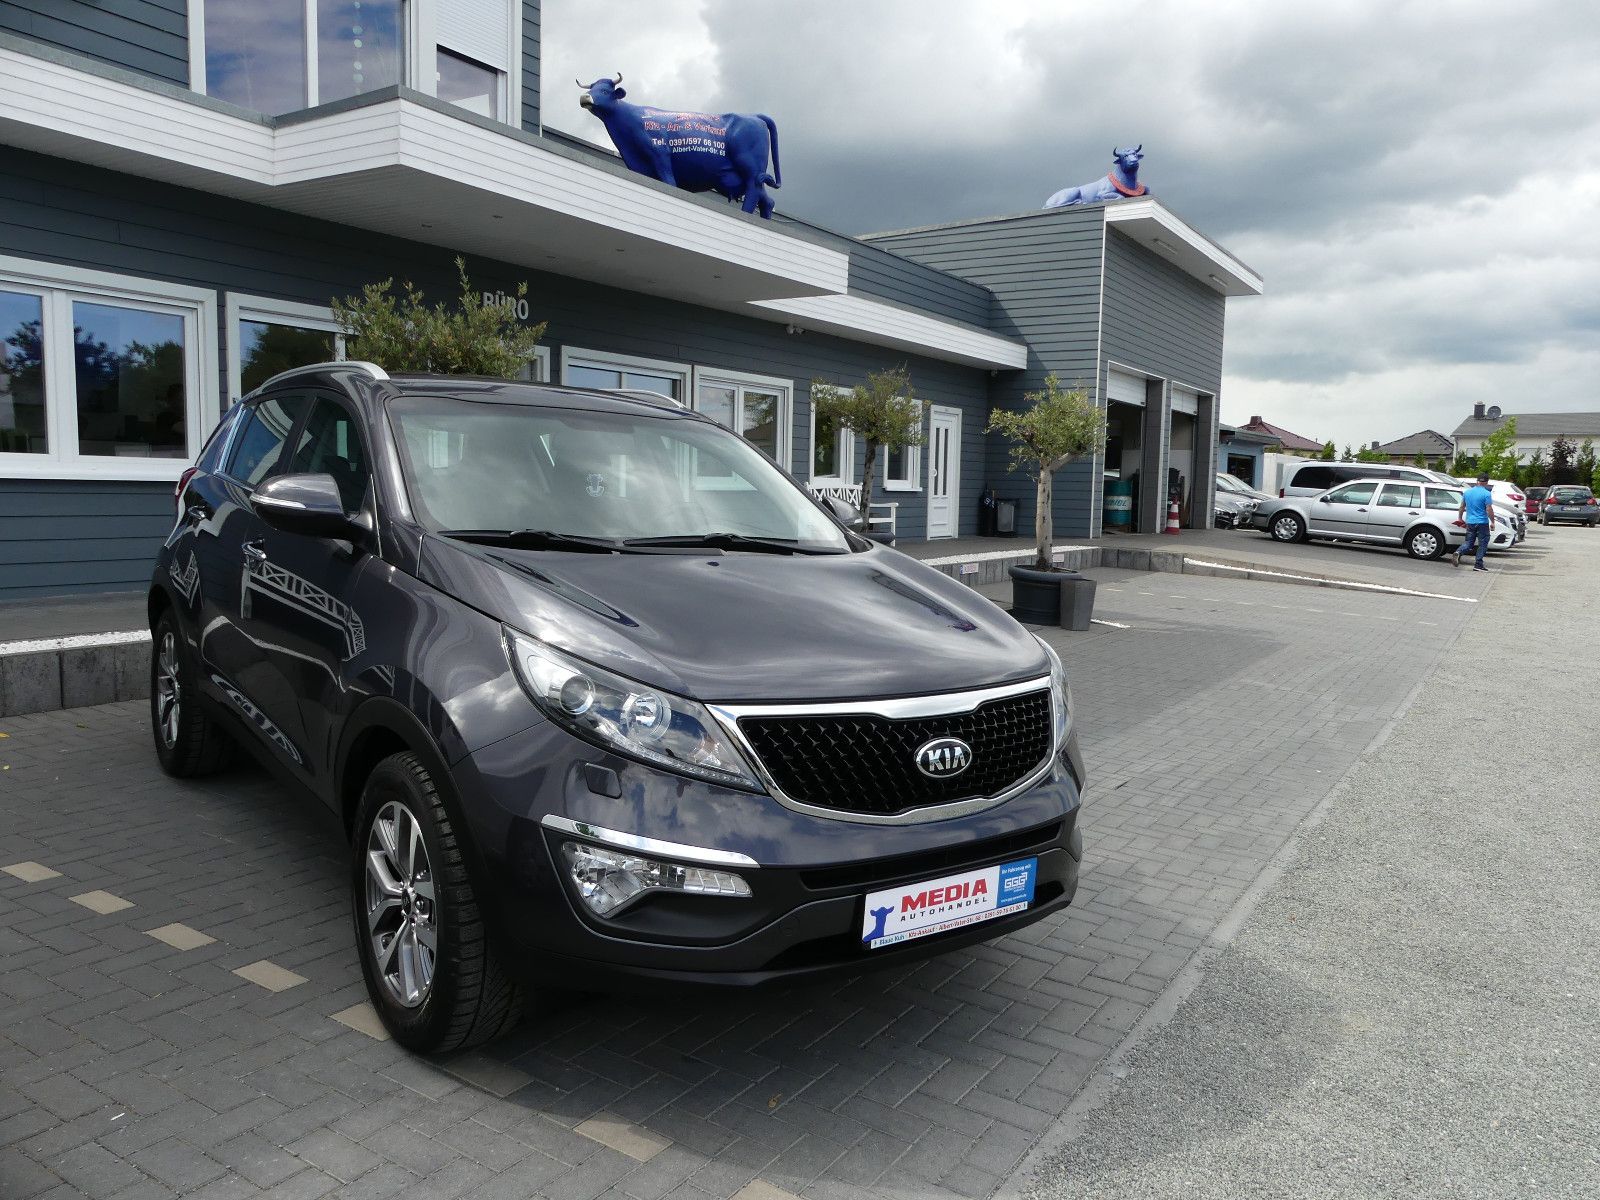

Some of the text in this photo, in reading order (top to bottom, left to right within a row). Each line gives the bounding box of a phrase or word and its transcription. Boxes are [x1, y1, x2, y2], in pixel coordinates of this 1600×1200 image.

[669, 138, 702, 146] 0391/597
[713, 141, 725, 149] 100
[927, 746, 966, 772] KIA
[900, 878, 988, 913] MEDIA
[900, 897, 988, 922] AUTOHANDEL
